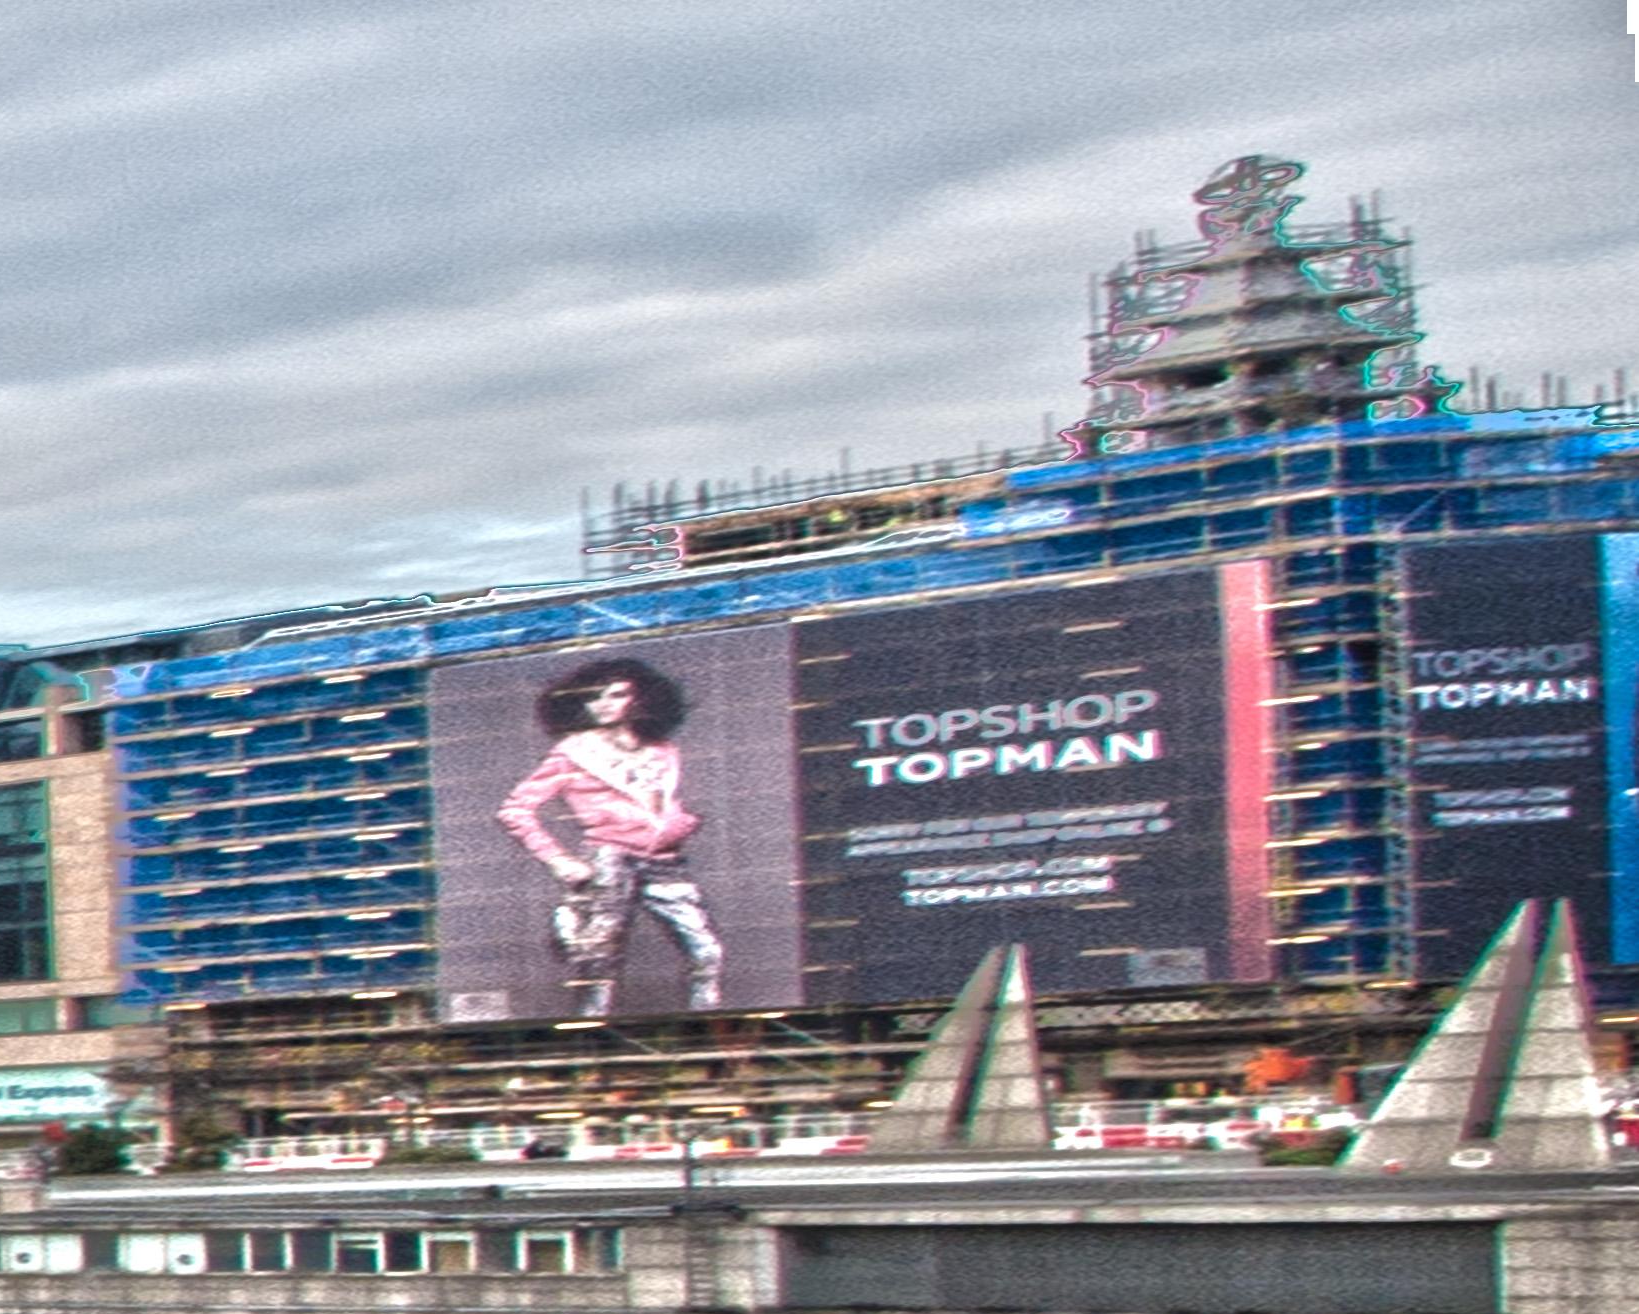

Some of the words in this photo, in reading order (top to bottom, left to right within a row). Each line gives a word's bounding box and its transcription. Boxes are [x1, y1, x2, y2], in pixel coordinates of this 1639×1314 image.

[1412, 642, 1592, 677] TOPSHOP
[1409, 674, 1598, 710] TOPMAN
[852, 689, 1159, 749] TOPSHOP
[852, 729, 1163, 786] TOPMAN
[901, 875, 1116, 907] TOPMAN.COM
[8, 1084, 95, 1102] Express
